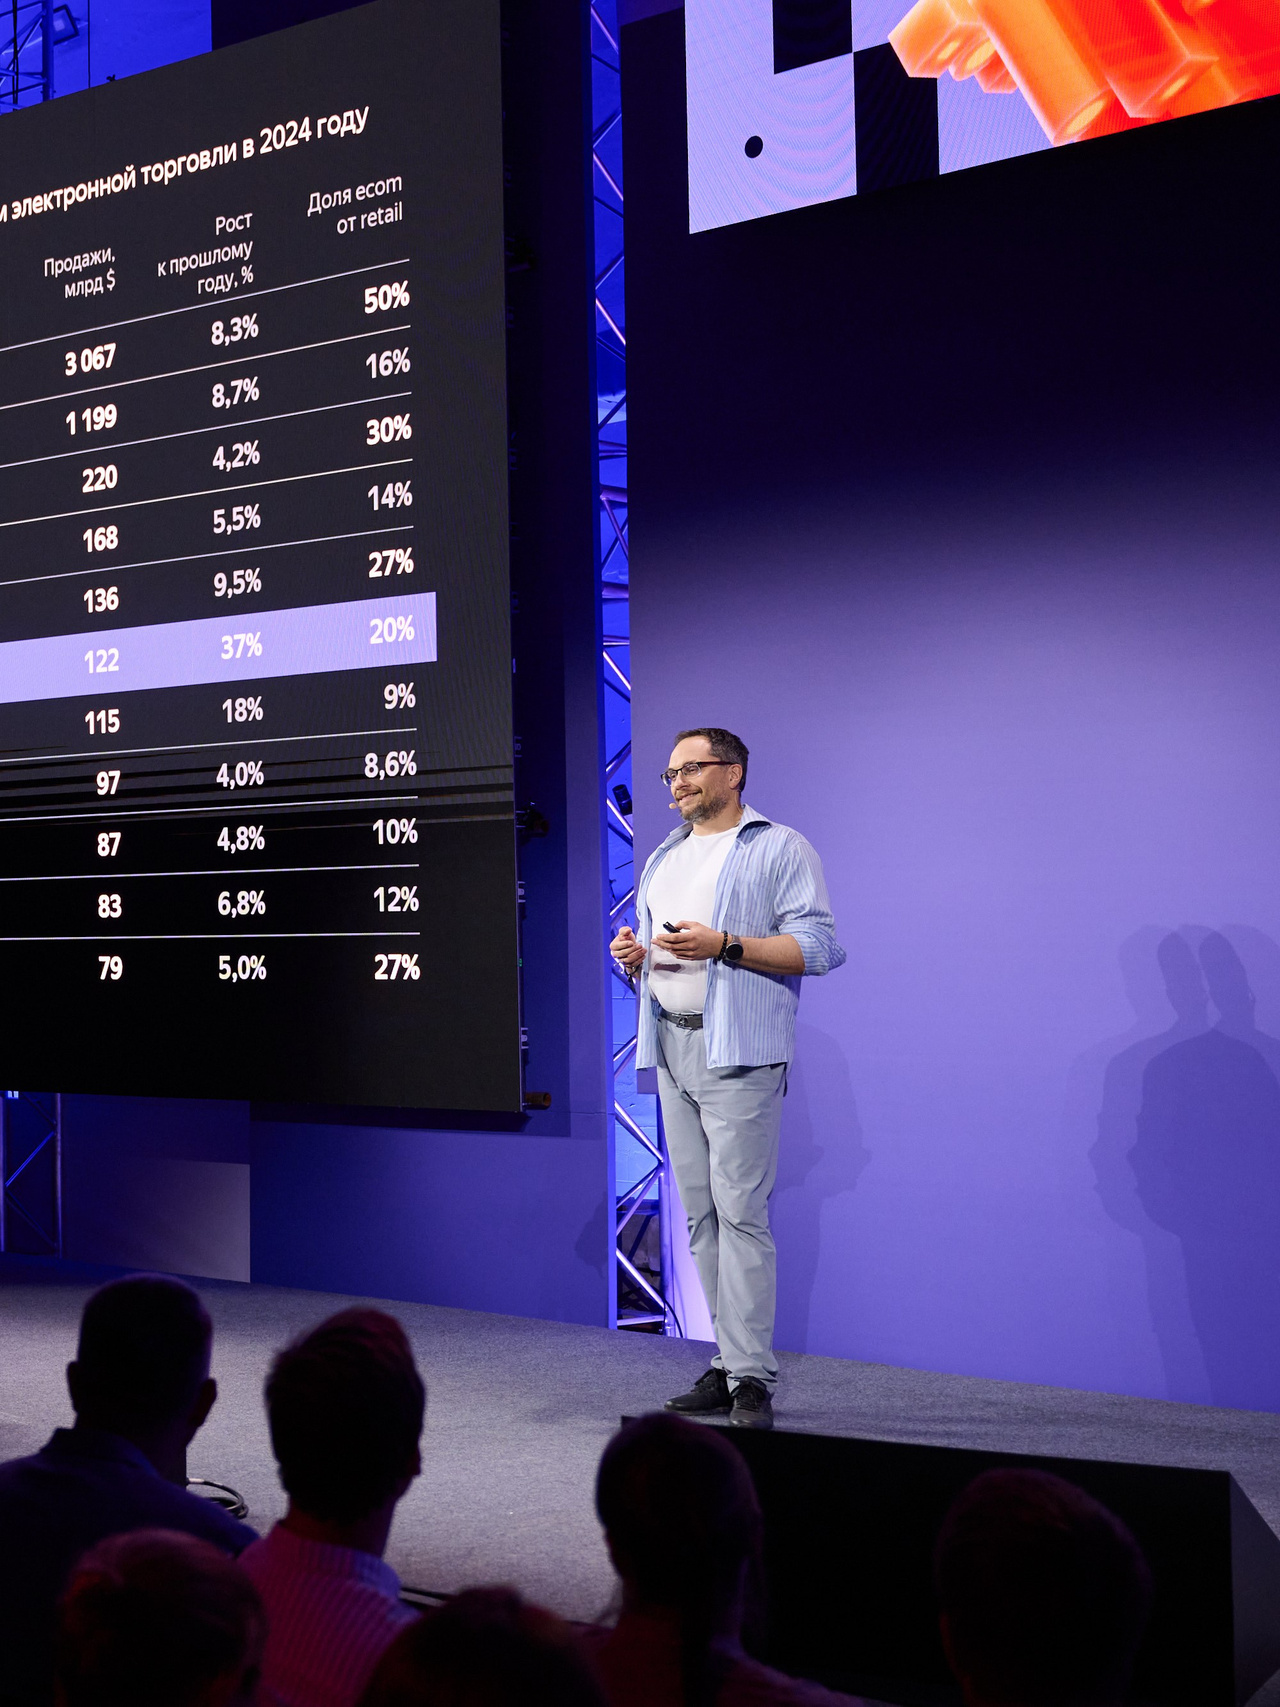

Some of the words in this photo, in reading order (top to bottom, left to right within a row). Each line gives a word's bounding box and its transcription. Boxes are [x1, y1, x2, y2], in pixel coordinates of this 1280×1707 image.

[11, 164, 136, 220] электронной
[140, 142, 237, 186] торговли
[242, 138, 255, 159] в
[259, 116, 313, 155] 2024
[317, 105, 370, 139] году
[307, 188, 352, 218] Доля
[355, 176, 402, 201] ecom
[215, 212, 253, 236] Рост
[336, 215, 357, 235] от
[360, 200, 403, 230] retail
[44, 247, 116, 279] Продажи,
[157, 261, 167, 278] к
[169, 240, 254, 276] прошлому
[64, 276, 104, 299] млрд
[106, 267, 116, 292] $
[197, 272, 238, 295] году,
[240, 266, 254, 285] %
[364, 280, 411, 314] 50%
[211, 312, 259, 347] 8,3%
[365, 346, 411, 379] 16%
[211, 375, 260, 409] 8,7%
[366, 413, 413, 446] 30%
[212, 439, 261, 473] 4,2%
[82, 464, 118, 494] 220
[367, 480, 413, 511] 14%
[213, 503, 262, 536] 5,5%
[82, 525, 119, 553] 168
[368, 546, 415, 578] 27%
[213, 567, 262, 599] 9,5%
[83, 586, 119, 614] 136
[369, 614, 415, 645] 20%
[84, 647, 120, 674] 122
[220, 631, 263, 660] 37%
[222, 695, 264, 723] 18%
[383, 681, 416, 710] 9%
[84, 708, 120, 735] 115
[216, 760, 265, 790] 4,0%
[364, 749, 418, 781] 8,6%
[96, 769, 121, 796] 97
[97, 831, 122, 857] 87
[216, 824, 266, 855] 4,8%
[372, 817, 419, 845] 10%
[97, 893, 122, 919] 83
[217, 889, 266, 919] 6,8%
[373, 885, 420, 913] 12%
[98, 955, 124, 981] 79
[218, 954, 267, 983] 5,0%
[374, 953, 421, 981] 27%
